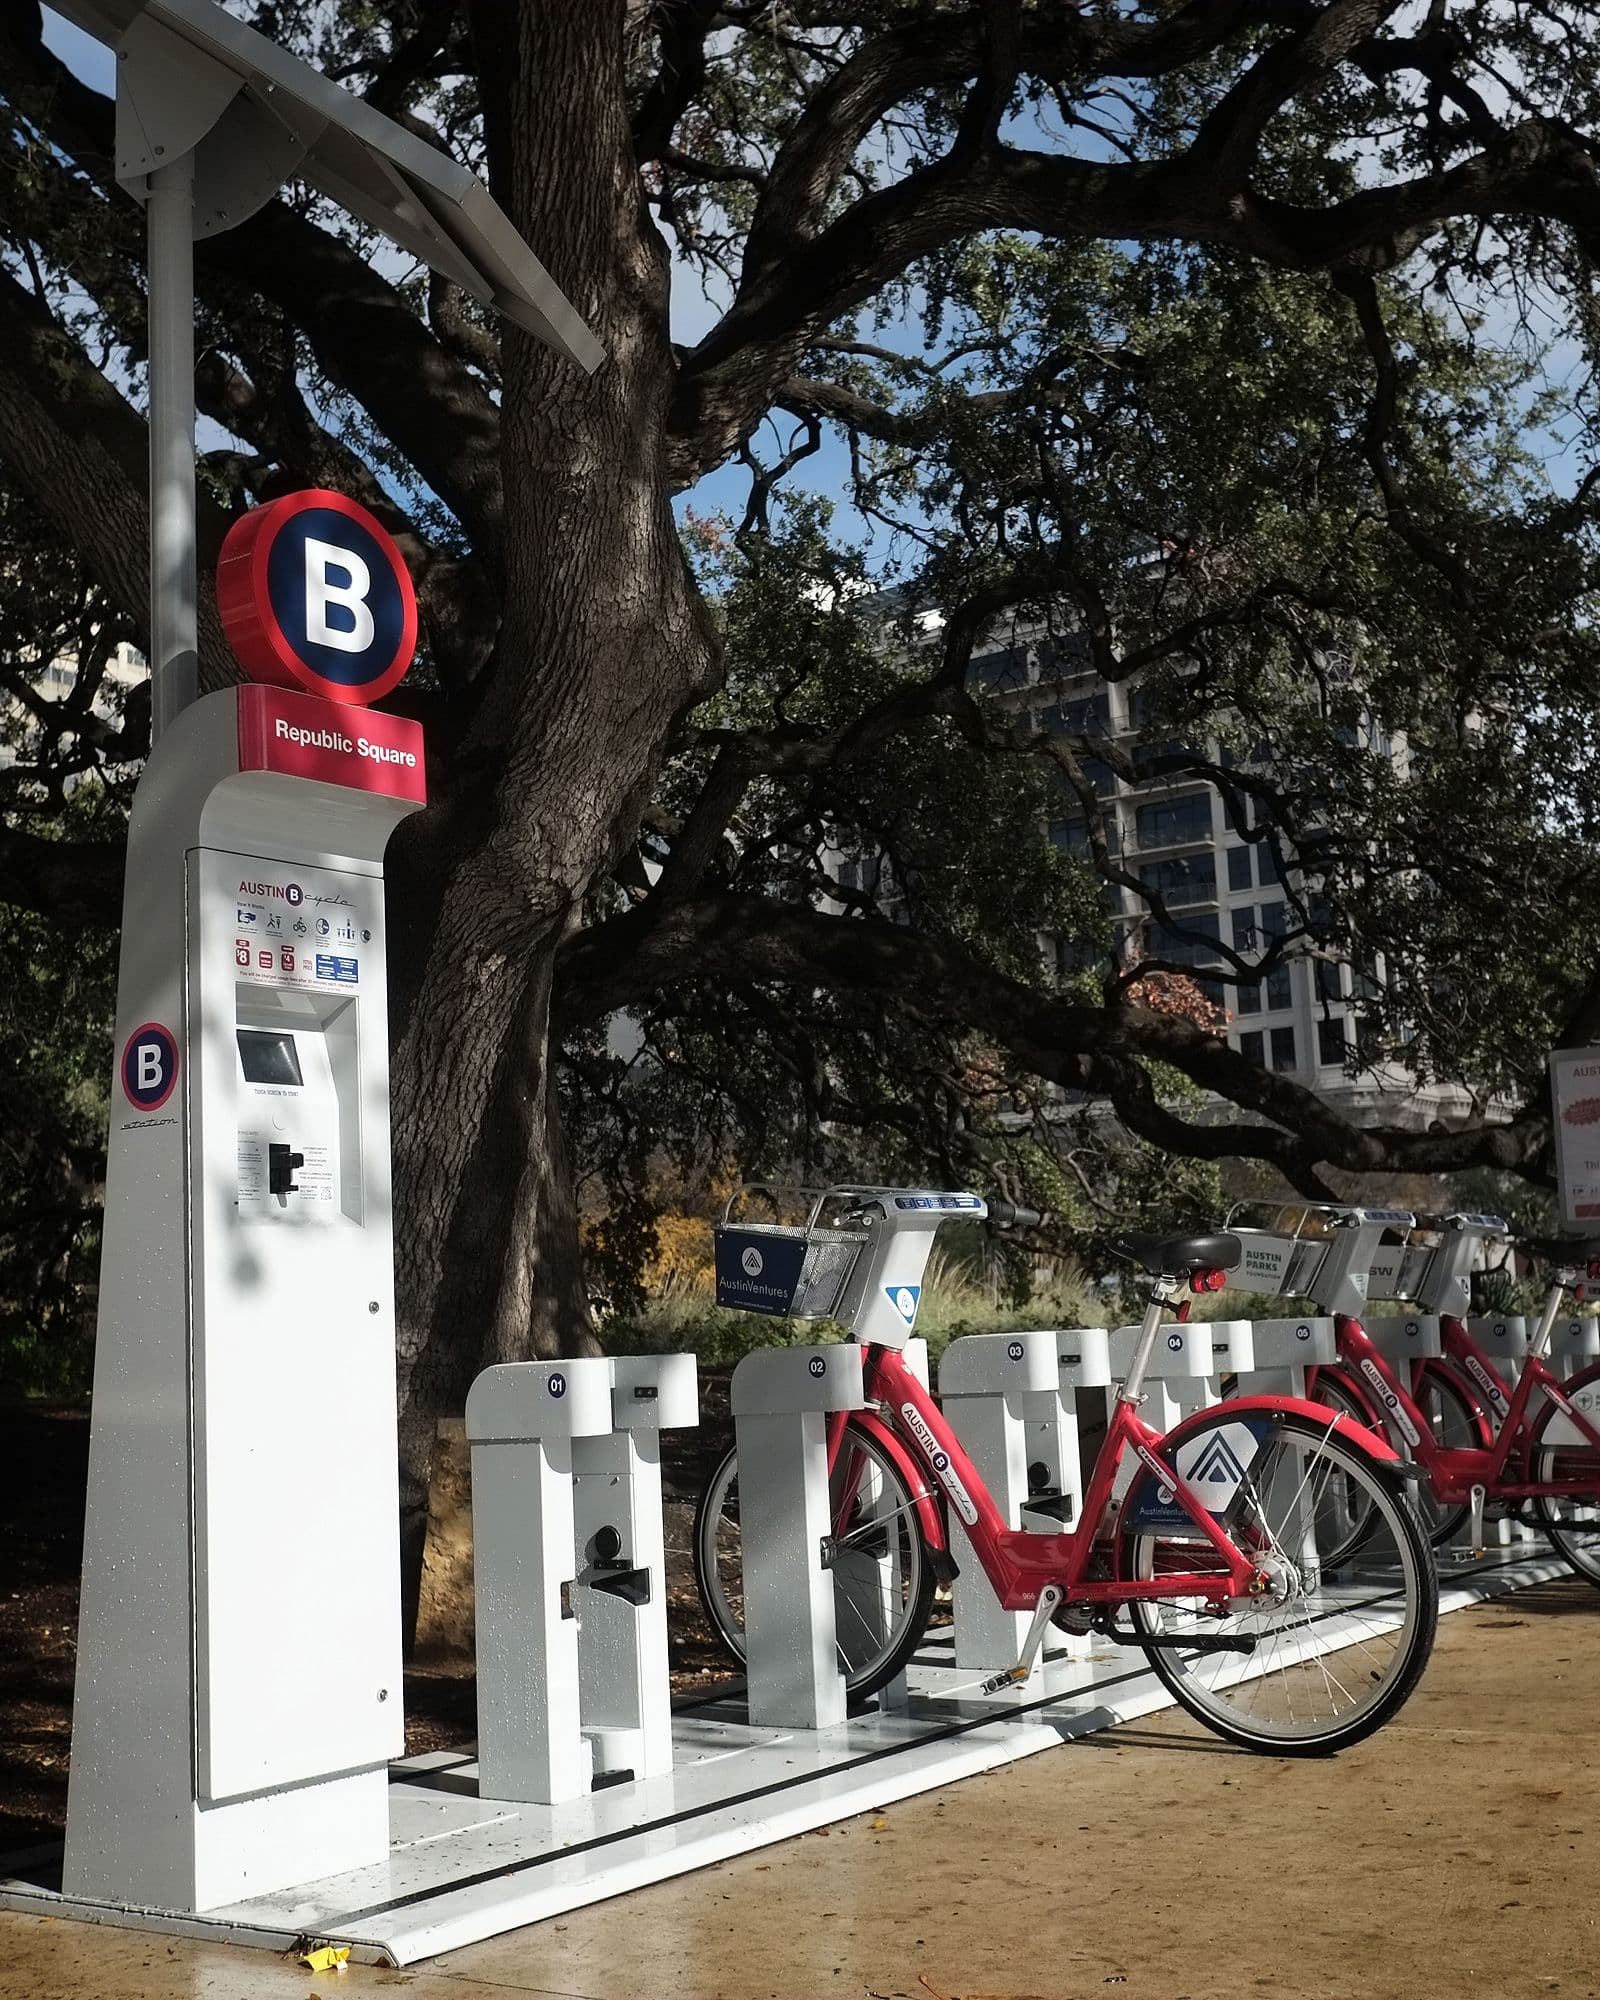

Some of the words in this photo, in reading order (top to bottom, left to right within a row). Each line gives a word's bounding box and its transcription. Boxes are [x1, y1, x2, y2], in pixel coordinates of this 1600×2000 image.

[305, 537, 375, 653] B
[275, 719, 353, 753] Republic
[356, 737, 417, 767] Square
[239, 881, 285, 899] AUSTIN
[289, 888, 299, 901] B
[304, 894, 357, 908] cycle
[138, 1044, 162, 1089] B
[120, 1118, 179, 1131] station
[1246, 1251, 1282, 1262] AUSTIN
[1246, 1260, 1278, 1272] PARKS
[719, 1276, 789, 1299] AustinVentures
[1297, 1328, 1309, 1338] 05
[1168, 1338, 1181, 1348] 04
[1009, 1346, 1022, 1357] 03
[810, 1361, 824, 1374] 02
[1467, 1359, 1493, 1390] AUSTIN
[550, 1378, 563, 1392] 01
[1363, 1362, 1388, 1397] AUSTIN
[904, 1408, 938, 1454] AUSTIN
[1139, 1506, 1189, 1517] AustinVentur
